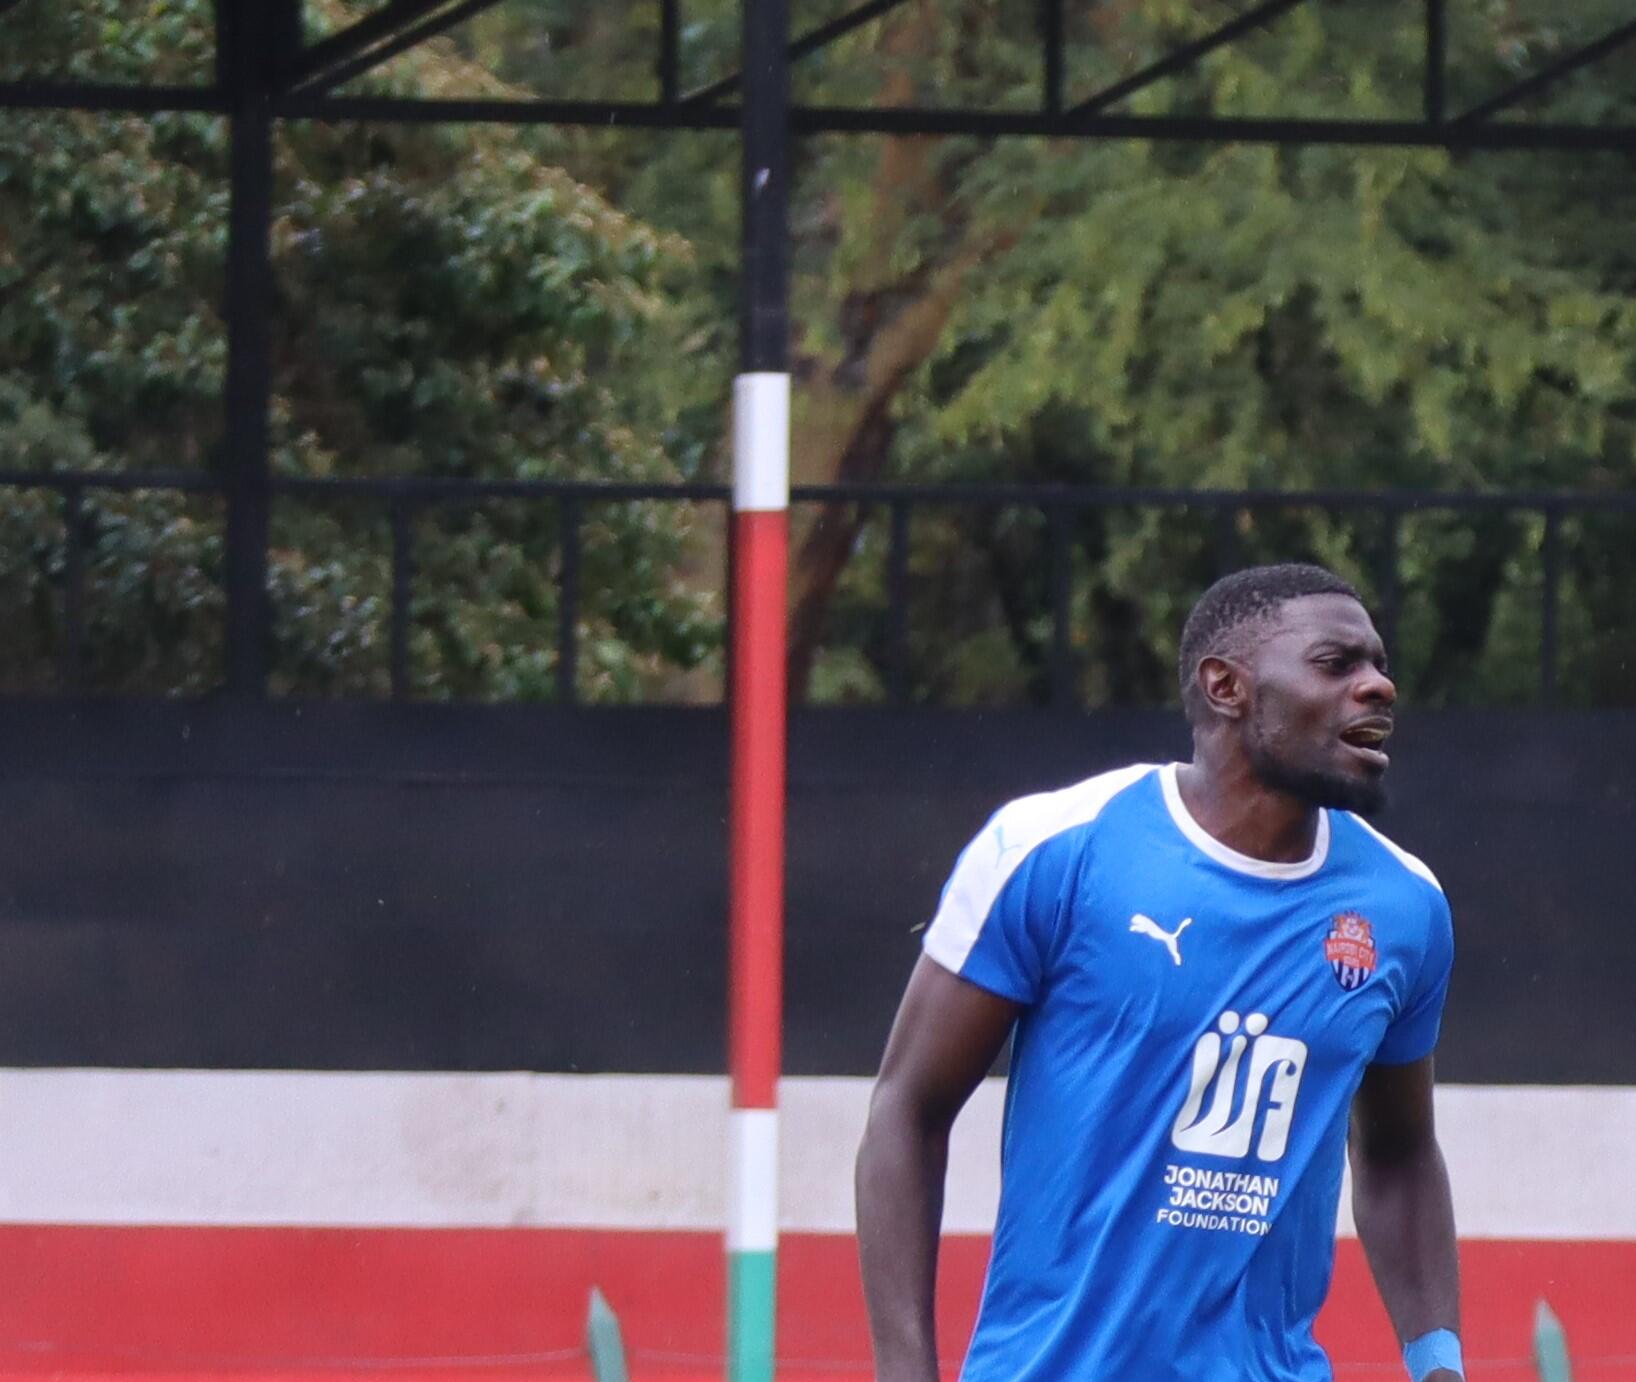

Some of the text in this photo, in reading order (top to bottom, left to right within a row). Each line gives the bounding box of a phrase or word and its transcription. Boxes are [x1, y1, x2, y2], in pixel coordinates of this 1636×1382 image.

[1163, 1164, 1279, 1197] JONATHAN
[1169, 1186, 1270, 1217] JACKSON
[1156, 1208, 1273, 1236] FOUNDATION
